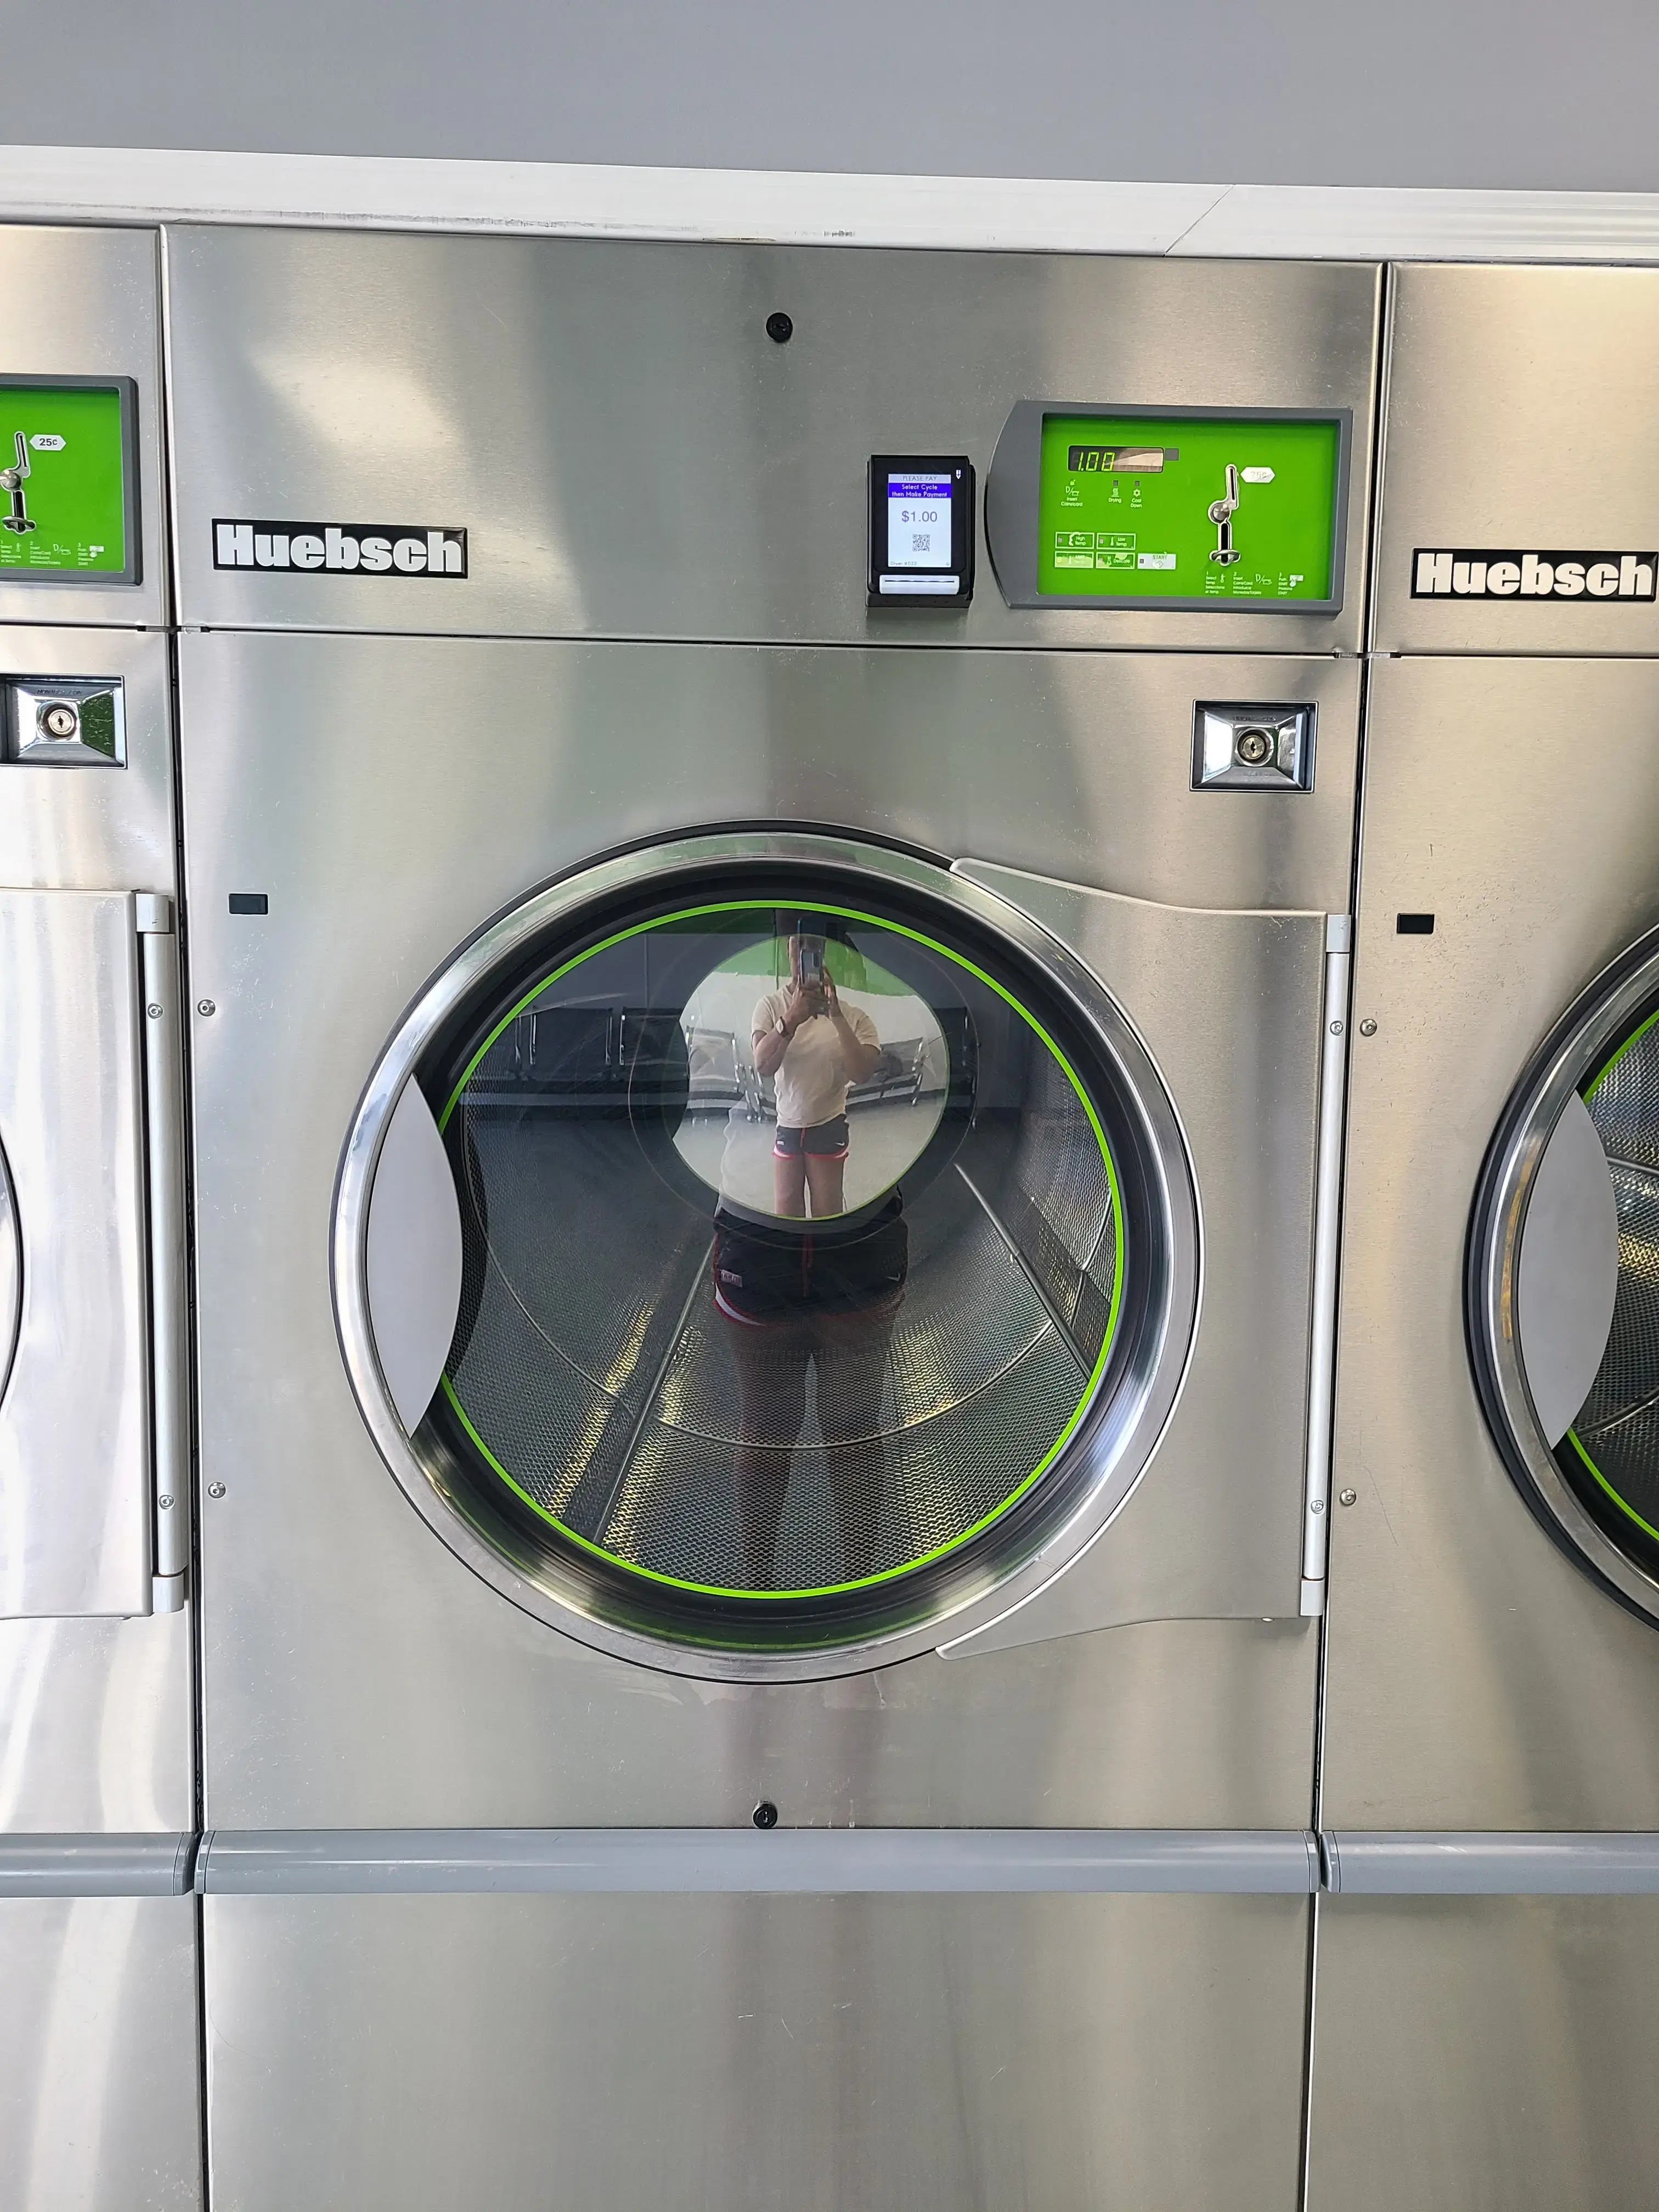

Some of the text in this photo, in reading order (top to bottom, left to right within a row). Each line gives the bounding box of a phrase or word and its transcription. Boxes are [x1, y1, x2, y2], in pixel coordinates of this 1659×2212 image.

[39, 438, 58, 447] 25¢
[1077, 452, 1115, 471] 1.00
[901, 510, 938, 523] $1.00
[217, 524, 462, 573] Huebsch
[1416, 553, 1653, 596] Huebsch
